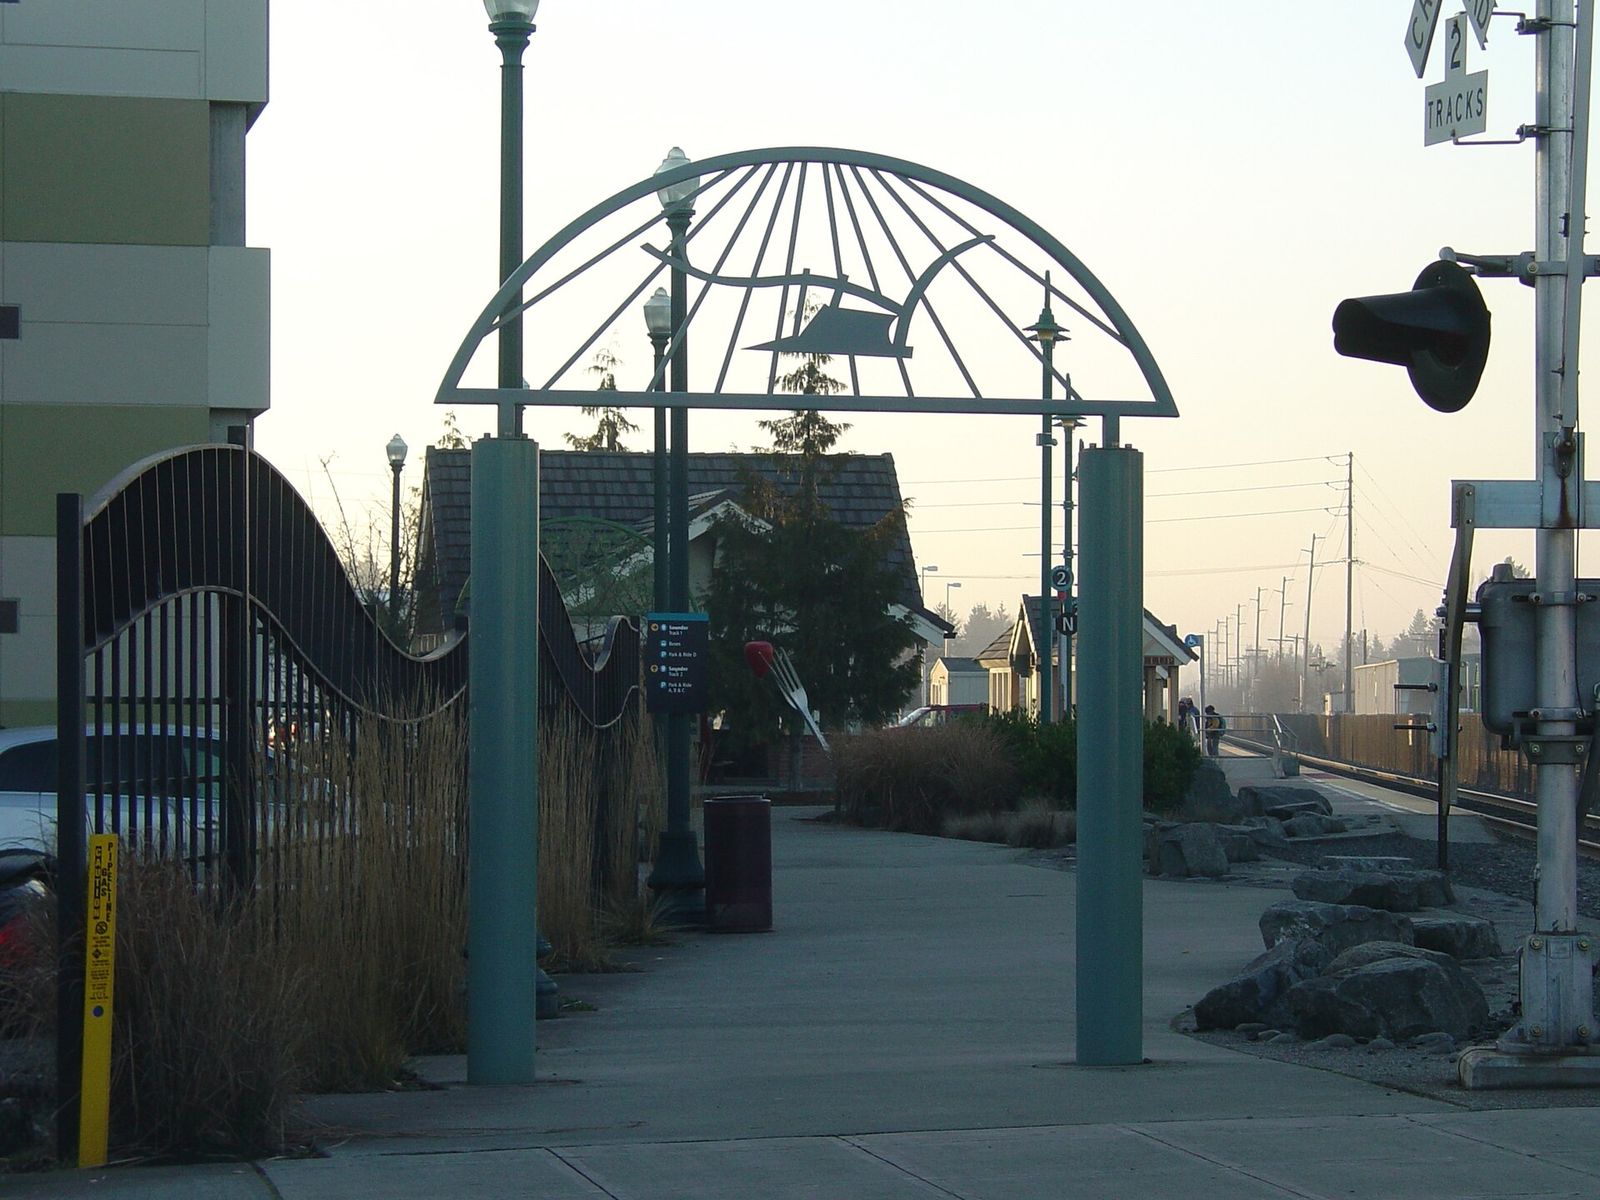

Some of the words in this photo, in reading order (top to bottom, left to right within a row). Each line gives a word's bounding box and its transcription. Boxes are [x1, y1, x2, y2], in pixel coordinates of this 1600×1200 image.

[1451, 24, 1461, 69] 2
[1428, 88, 1483, 129] TRACKS
[1056, 571, 1067, 585] 2
[1062, 616, 1074, 632] N
[106, 842, 114, 922] PIPELINE
